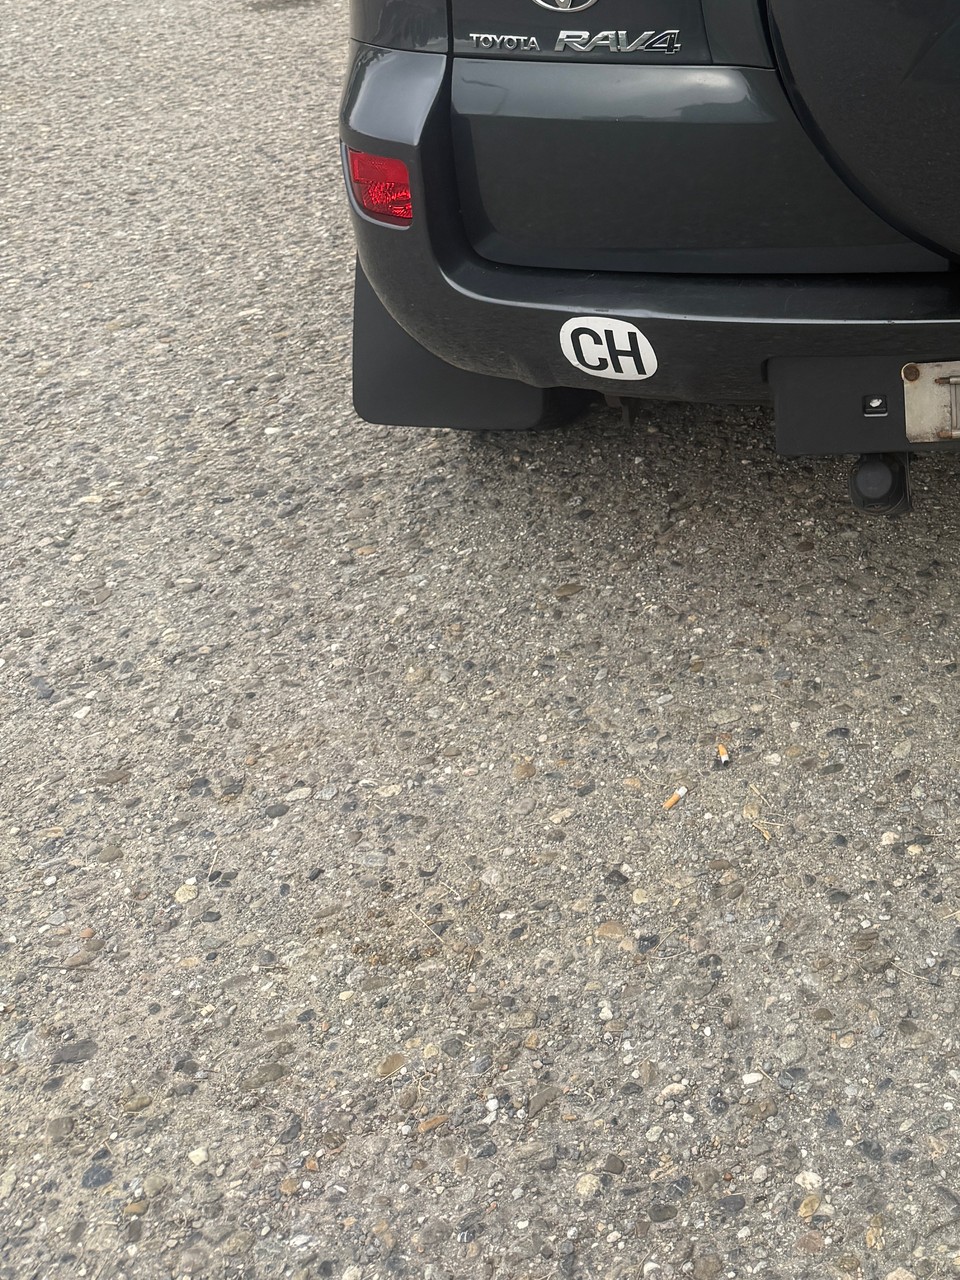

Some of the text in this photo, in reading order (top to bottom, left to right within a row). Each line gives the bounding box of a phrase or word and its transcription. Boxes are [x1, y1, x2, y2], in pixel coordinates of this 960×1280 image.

[469, 29, 681, 55] TOYOTA RAV4
[571, 326, 647, 376] CH
